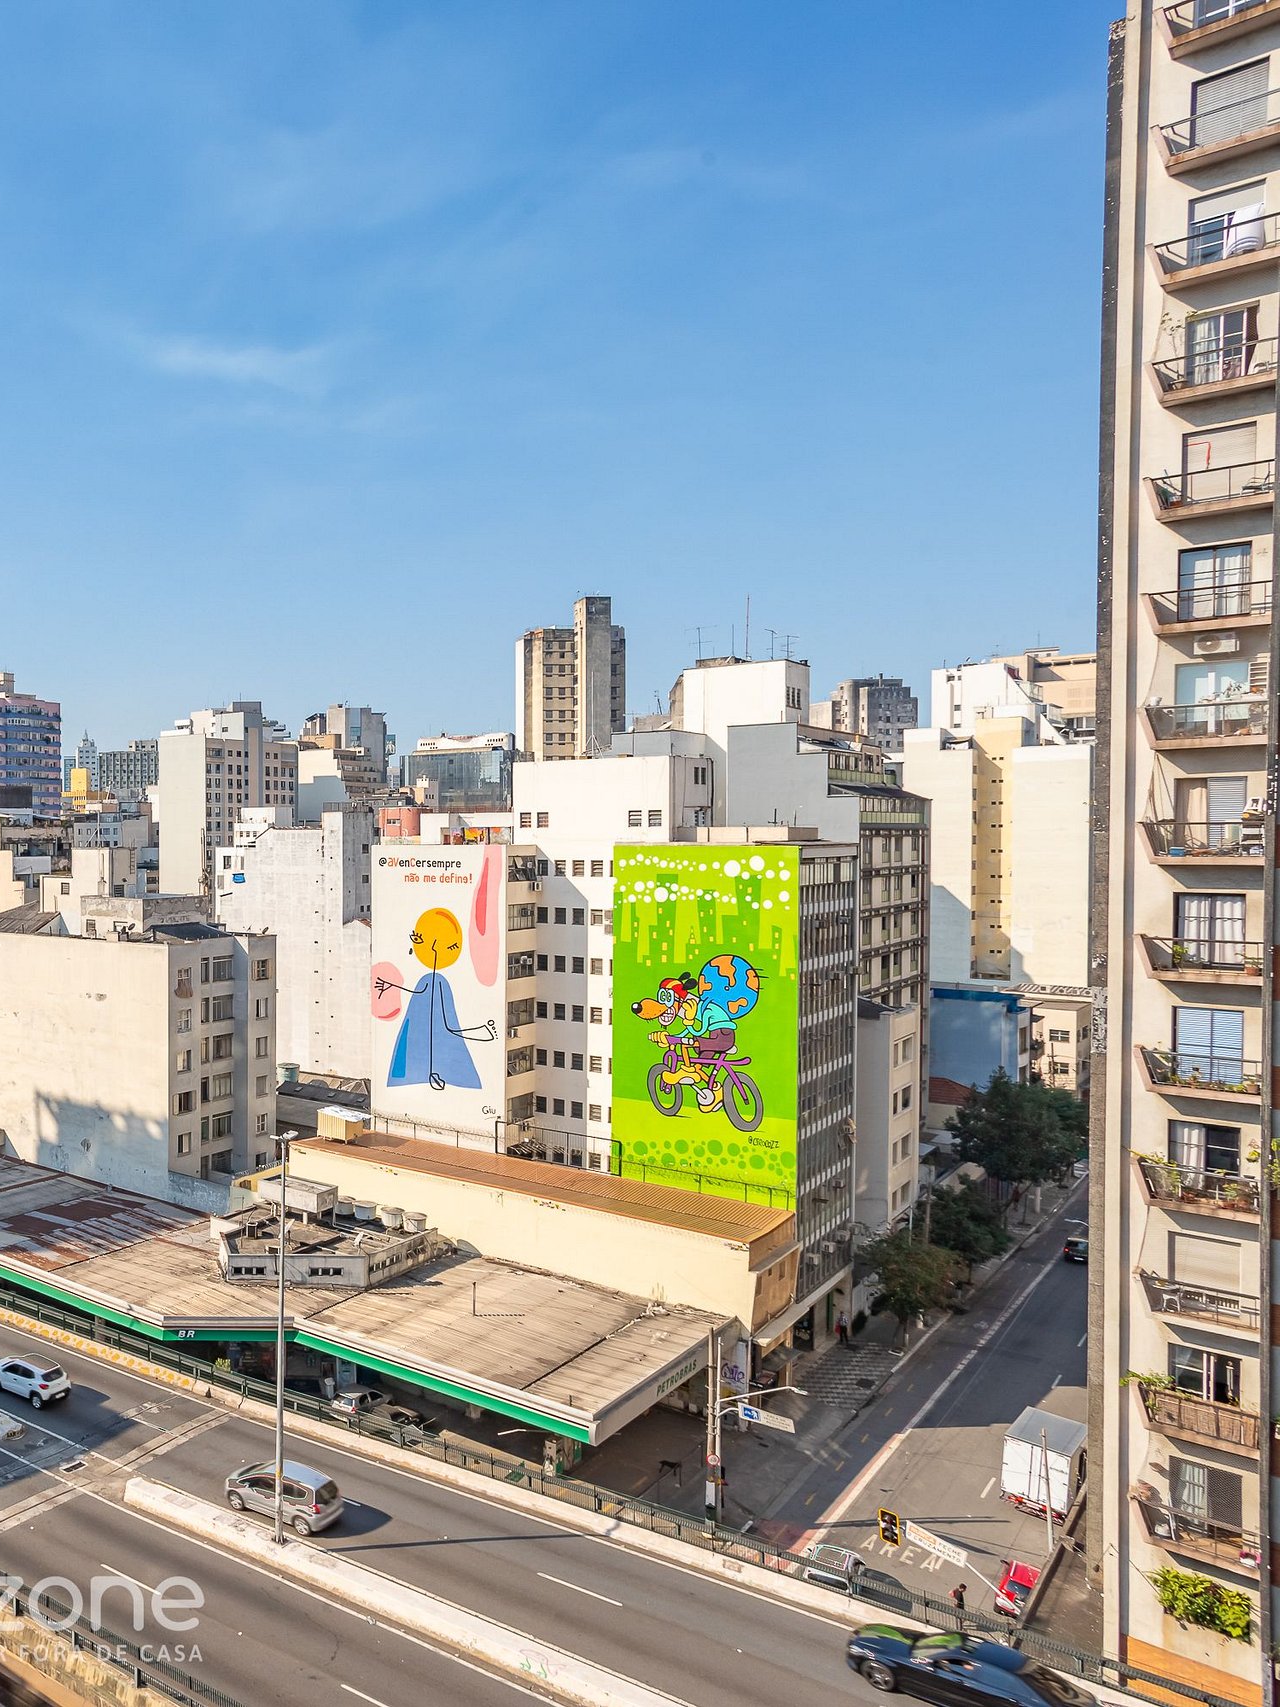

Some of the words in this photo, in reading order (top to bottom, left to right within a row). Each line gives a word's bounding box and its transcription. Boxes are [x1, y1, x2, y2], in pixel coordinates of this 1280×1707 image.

[404, 873, 420, 883] não
[423, 875, 437, 883] me
[439, 873, 473, 884] define!
[178, 1330, 195, 1338] BR
[656, 1359, 697, 1397] PETROBRAS
